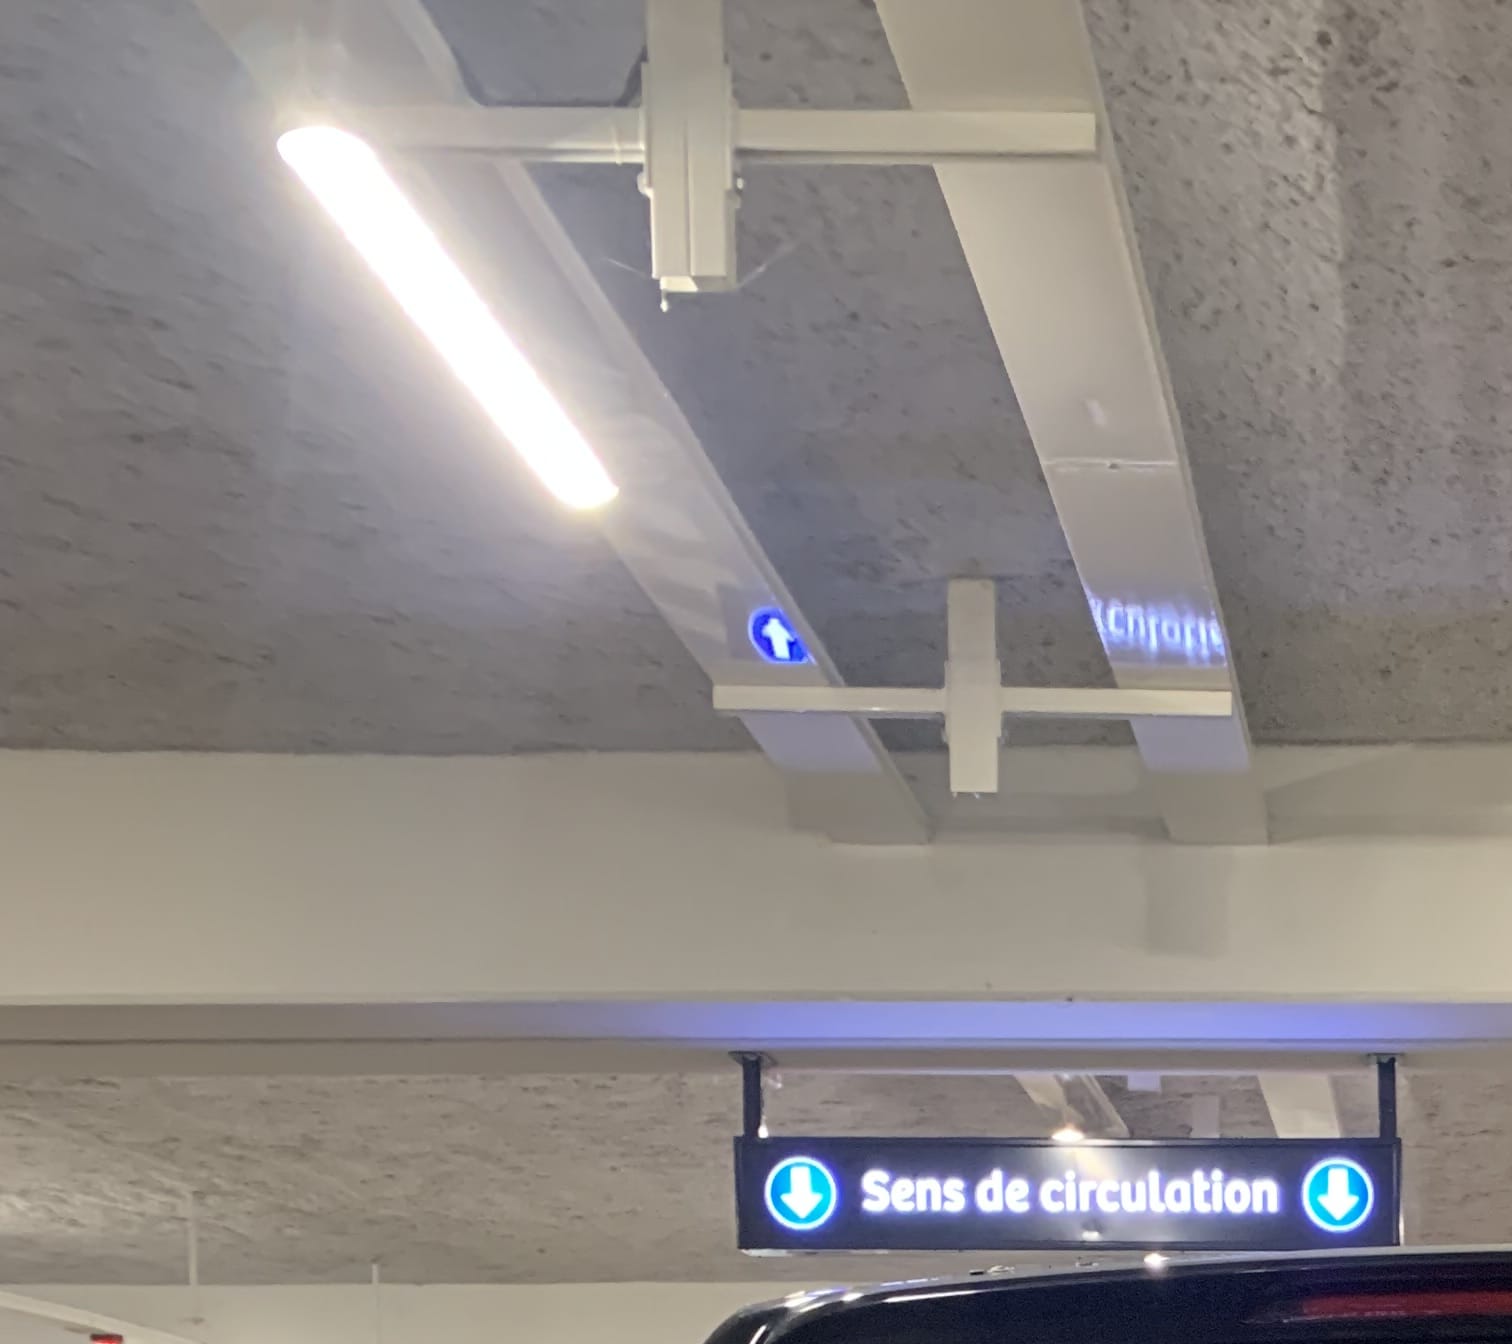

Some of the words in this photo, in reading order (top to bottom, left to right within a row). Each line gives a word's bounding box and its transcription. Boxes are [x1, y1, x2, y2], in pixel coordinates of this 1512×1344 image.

[862, 1168, 966, 1213] Sens
[976, 1169, 1027, 1213] de
[1040, 1169, 1279, 1214] circulation
